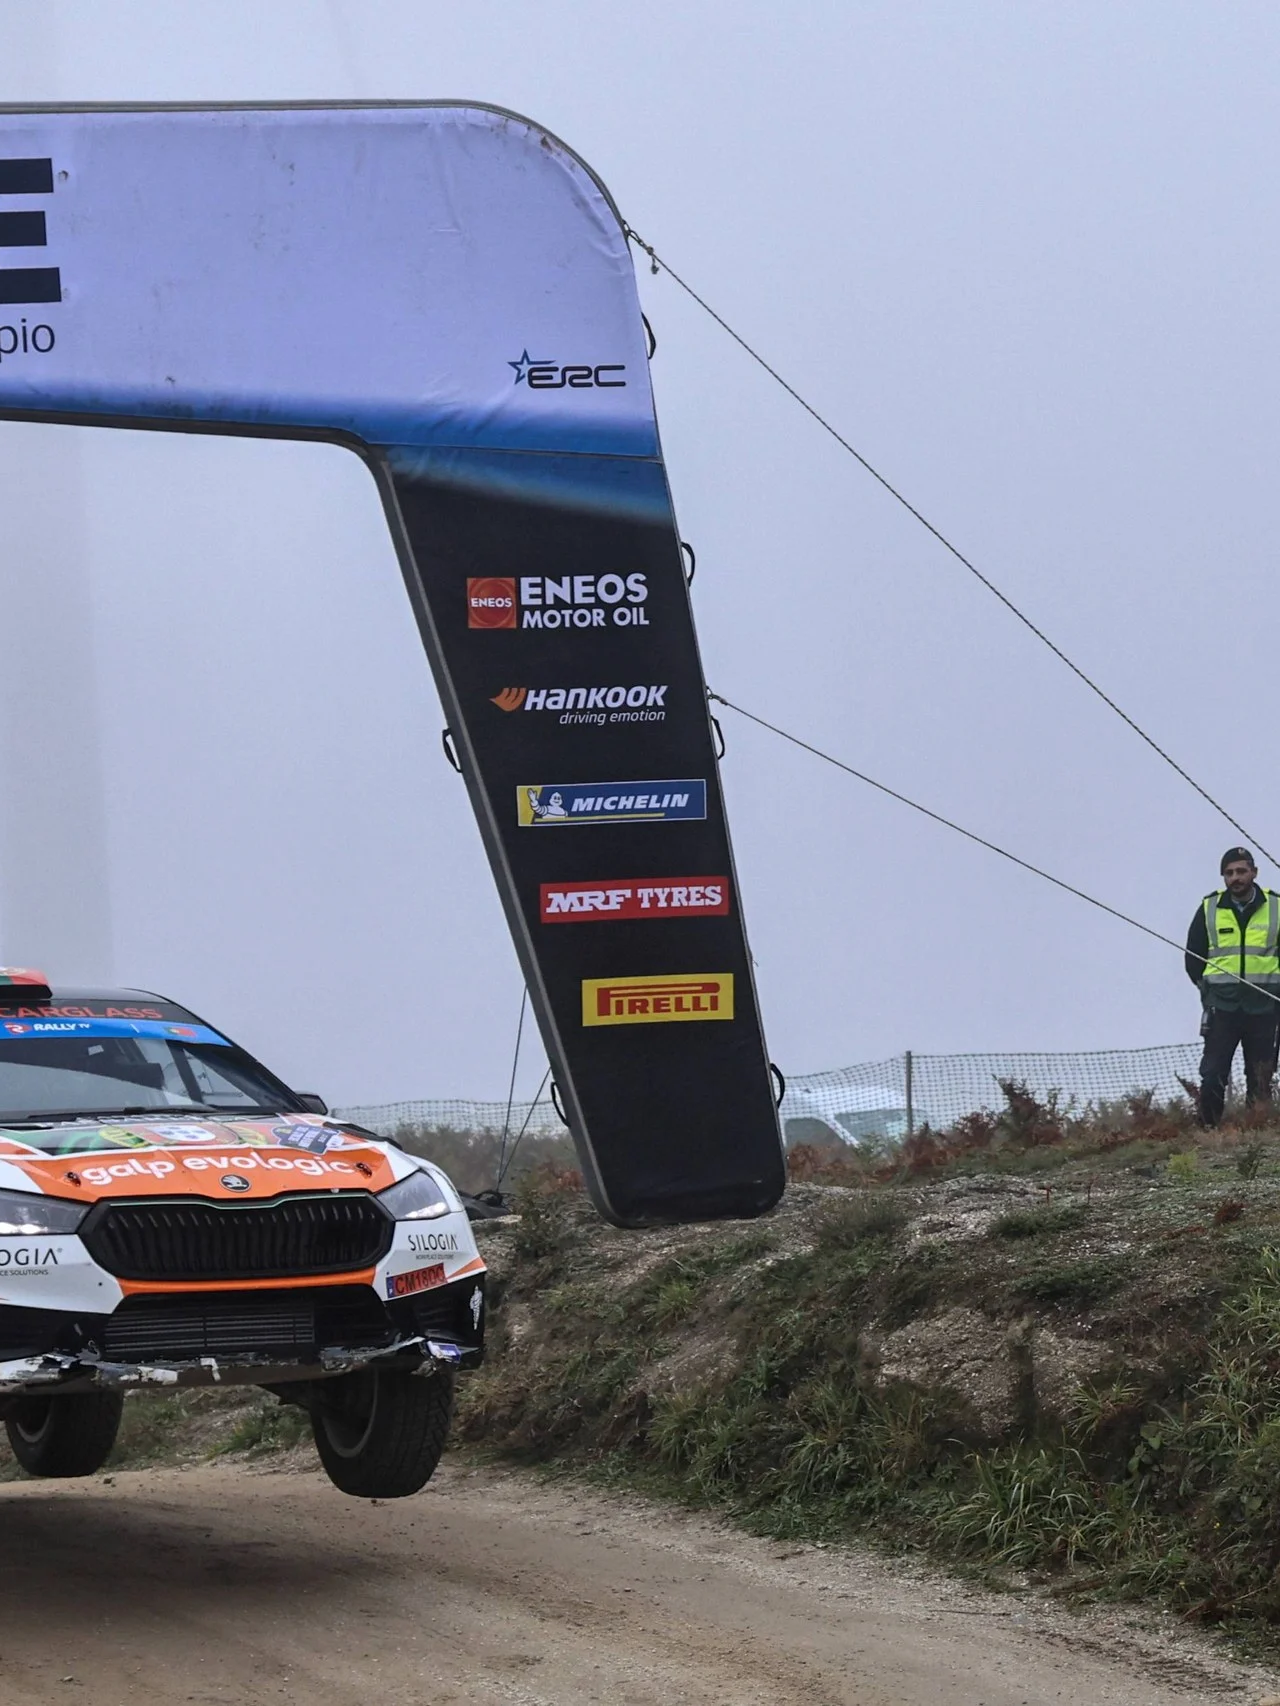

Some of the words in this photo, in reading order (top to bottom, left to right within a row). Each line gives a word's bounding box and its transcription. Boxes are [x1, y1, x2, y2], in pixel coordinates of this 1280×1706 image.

[527, 365, 626, 389] ERC
[520, 573, 649, 606] ENEOS
[471, 597, 512, 608] ENEOS
[522, 608, 607, 629] MOTOR
[612, 607, 650, 626] OIL
[559, 711, 607, 726] driving
[609, 709, 666, 723] emotion
[571, 793, 690, 813] MICHELIN
[545, 889, 632, 914] MRF
[637, 885, 723, 909] TYRES
[596, 981, 721, 1017] PIRELLI
[33, 1023, 76, 1032] RALLY
[81, 1158, 176, 1185] galp
[183, 1152, 358, 1176] evologic
[407, 1233, 459, 1251] SILOGIA
